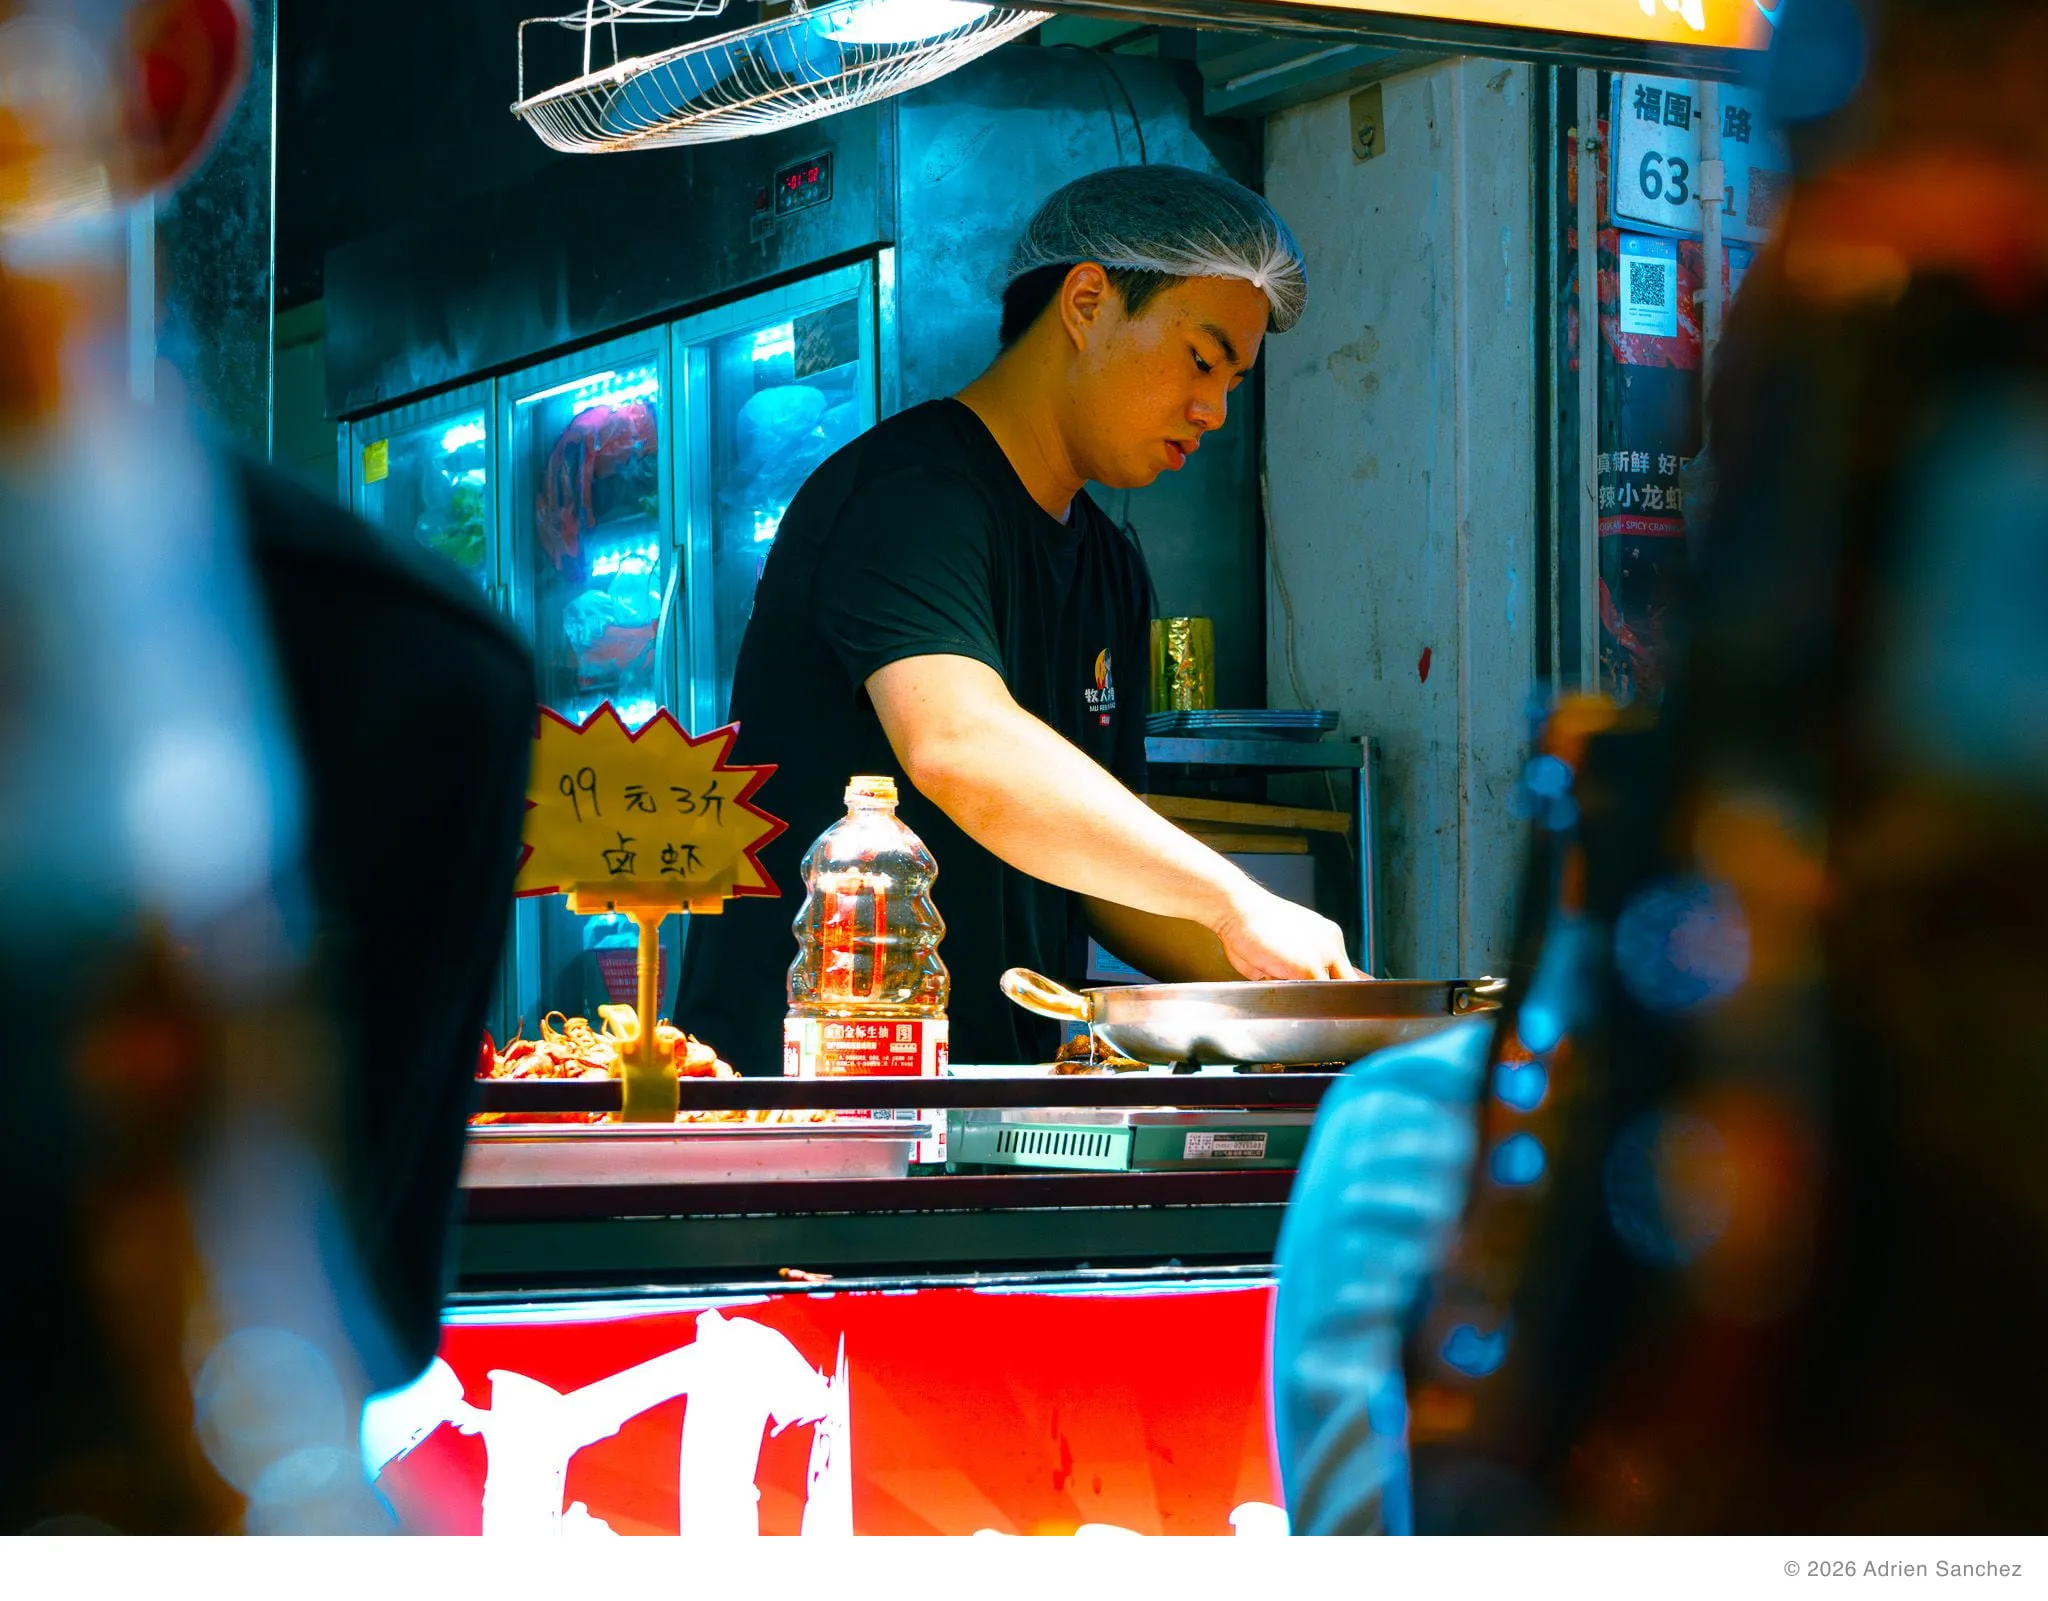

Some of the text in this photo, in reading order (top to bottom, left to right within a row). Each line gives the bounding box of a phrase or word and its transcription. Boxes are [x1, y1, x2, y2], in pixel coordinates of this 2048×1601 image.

[1633, 83, 1752, 144] 福围路
[1625, 520, 1647, 530] SPICY
